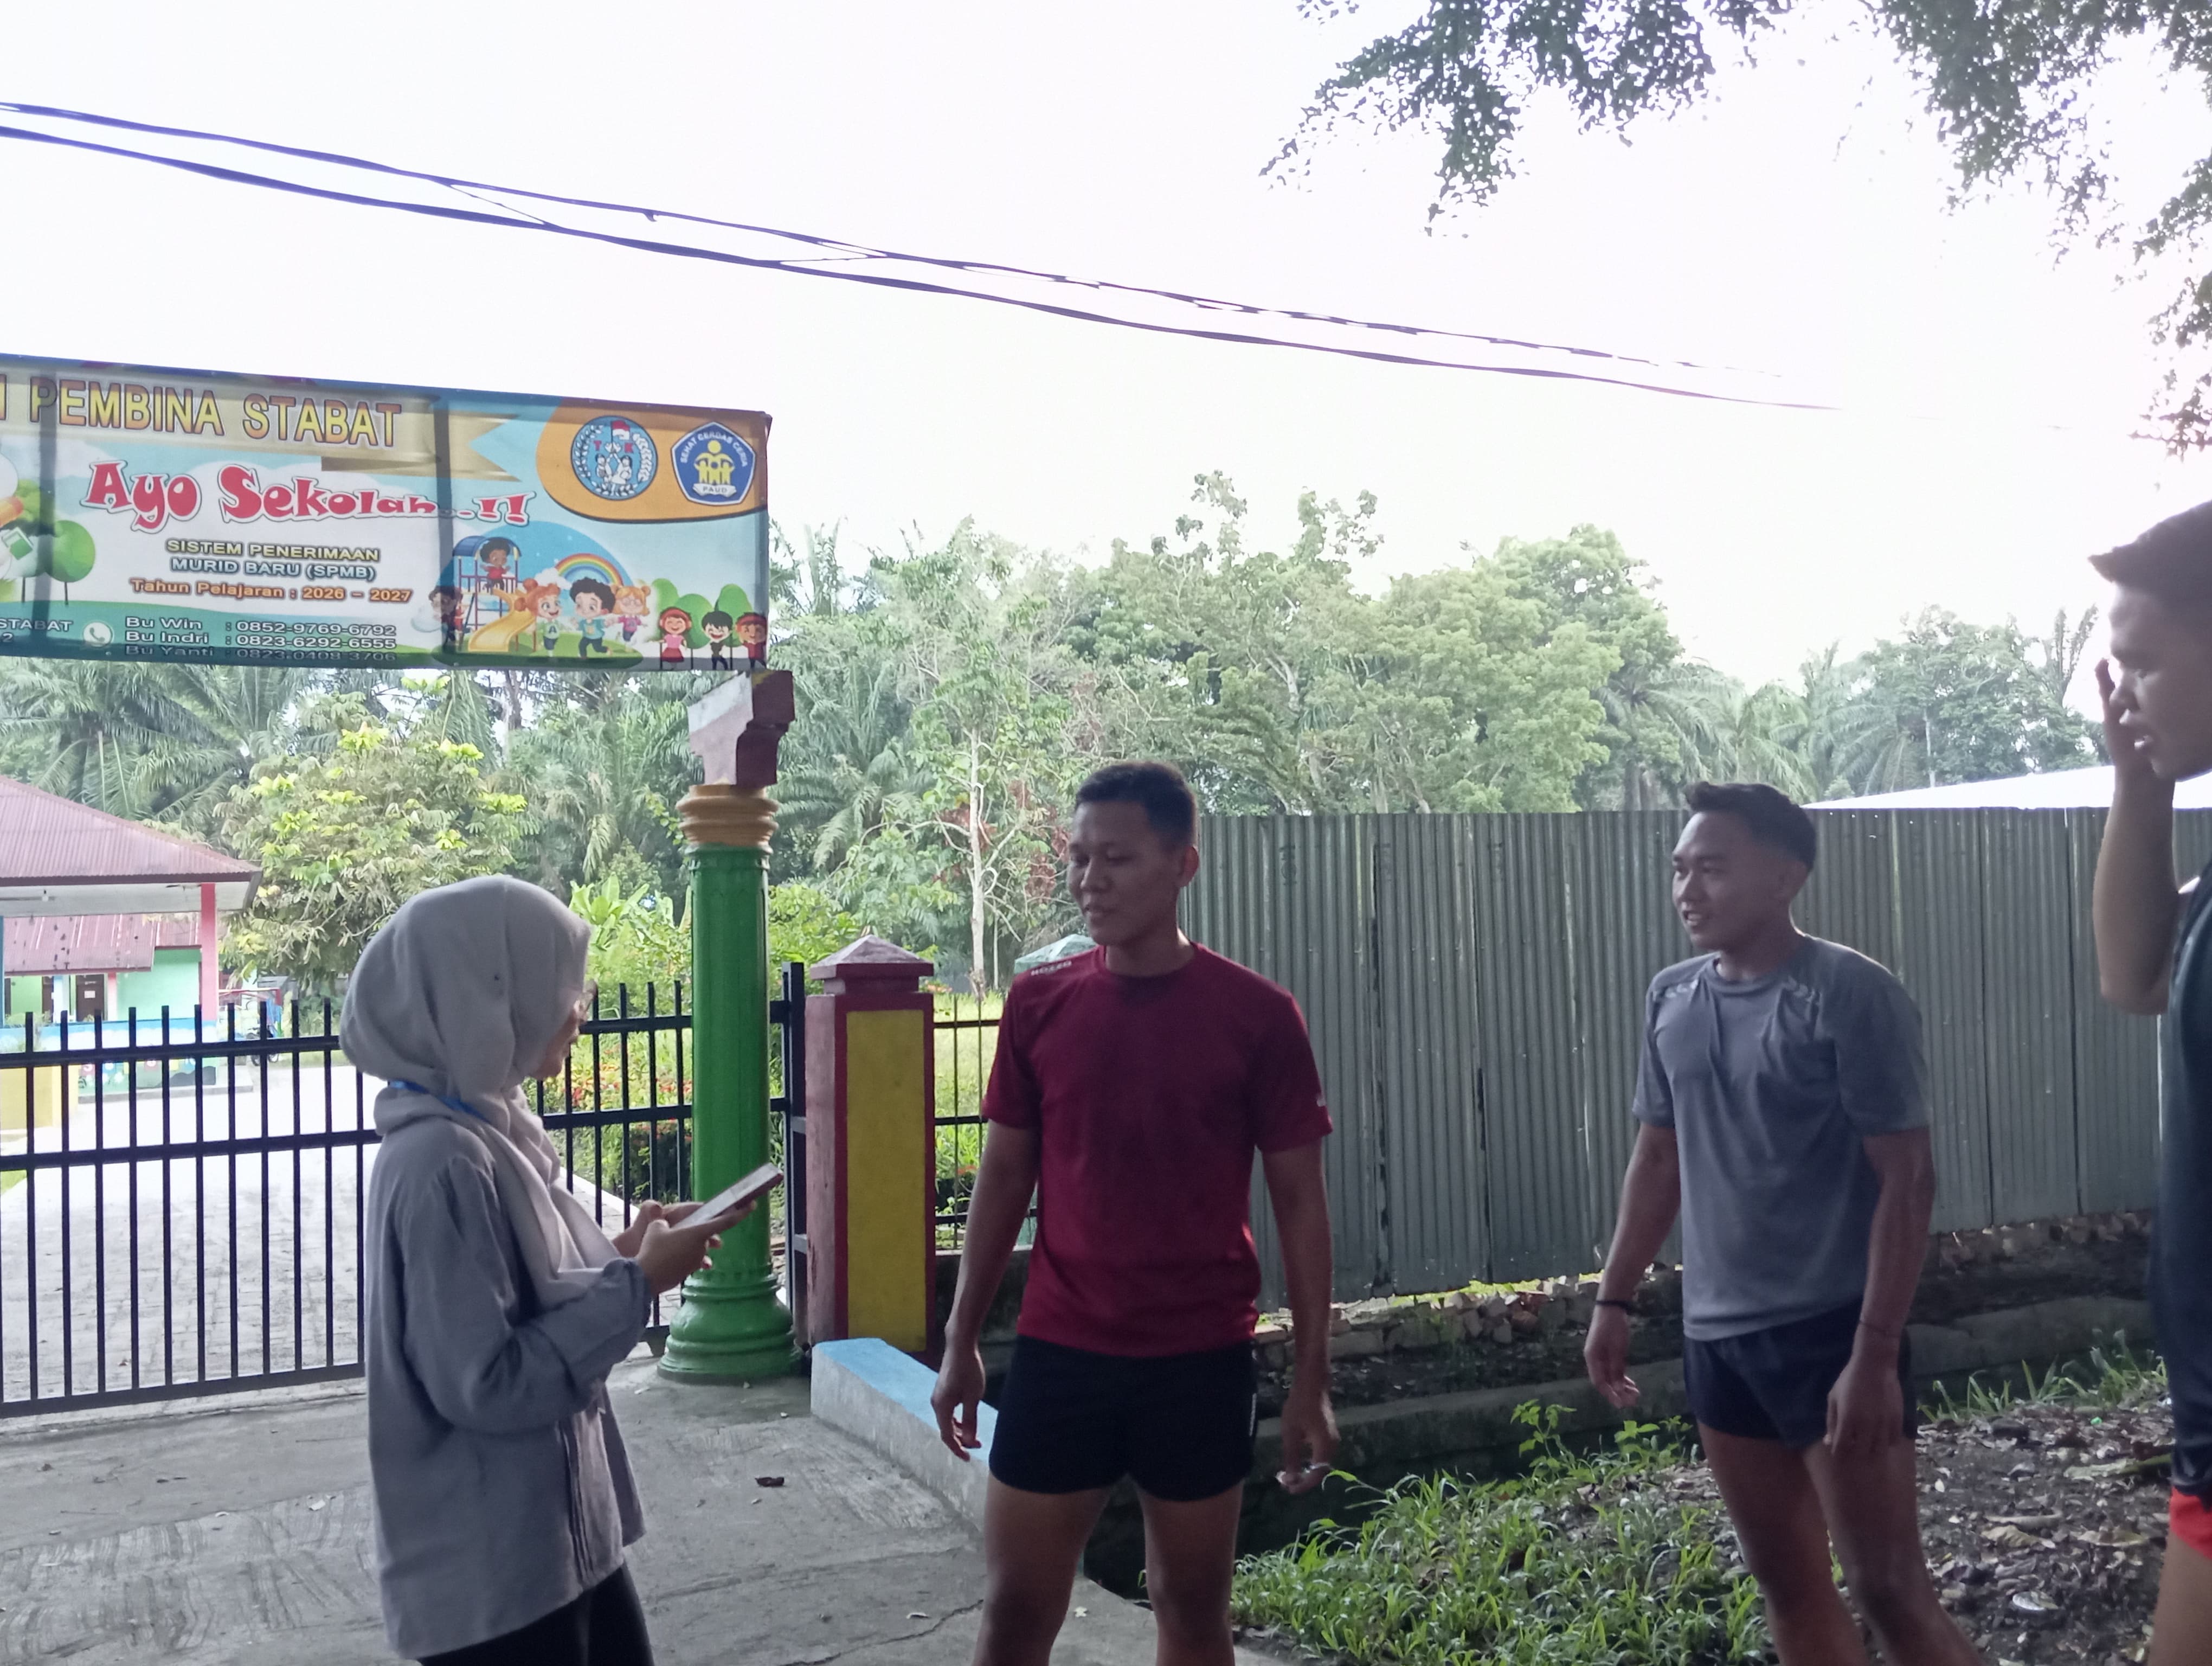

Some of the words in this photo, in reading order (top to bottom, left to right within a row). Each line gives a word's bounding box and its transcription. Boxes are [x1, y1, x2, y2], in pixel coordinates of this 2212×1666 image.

[30, 376, 224, 436] PEMBINA
[243, 393, 402, 447] STABAT
[82, 461, 199, 531] Ayo
[166, 540, 242, 555] SISTEM
[249, 544, 379, 561] PENERIMAAN
[171, 558, 239, 573] MURID
[245, 562, 299, 576] BARU
[305, 565, 376, 581] (SPMB)
[131, 579, 190, 593] Tahun
[197, 582, 284, 599] Pelajaran
[303, 587, 345, 600] 2026
[370, 589, 411, 602] 2027
[126, 617, 154, 628] Bu
[160, 618, 202, 630] Win
[236, 621, 397, 636] 0852-9769-6792
[126, 631, 154, 642] Bu
[161, 632, 209, 643] Indri
[236, 635, 397, 649] 0823-6292-6555
[126, 646, 153, 655] Bu
[160, 646, 214, 656] Yanti
